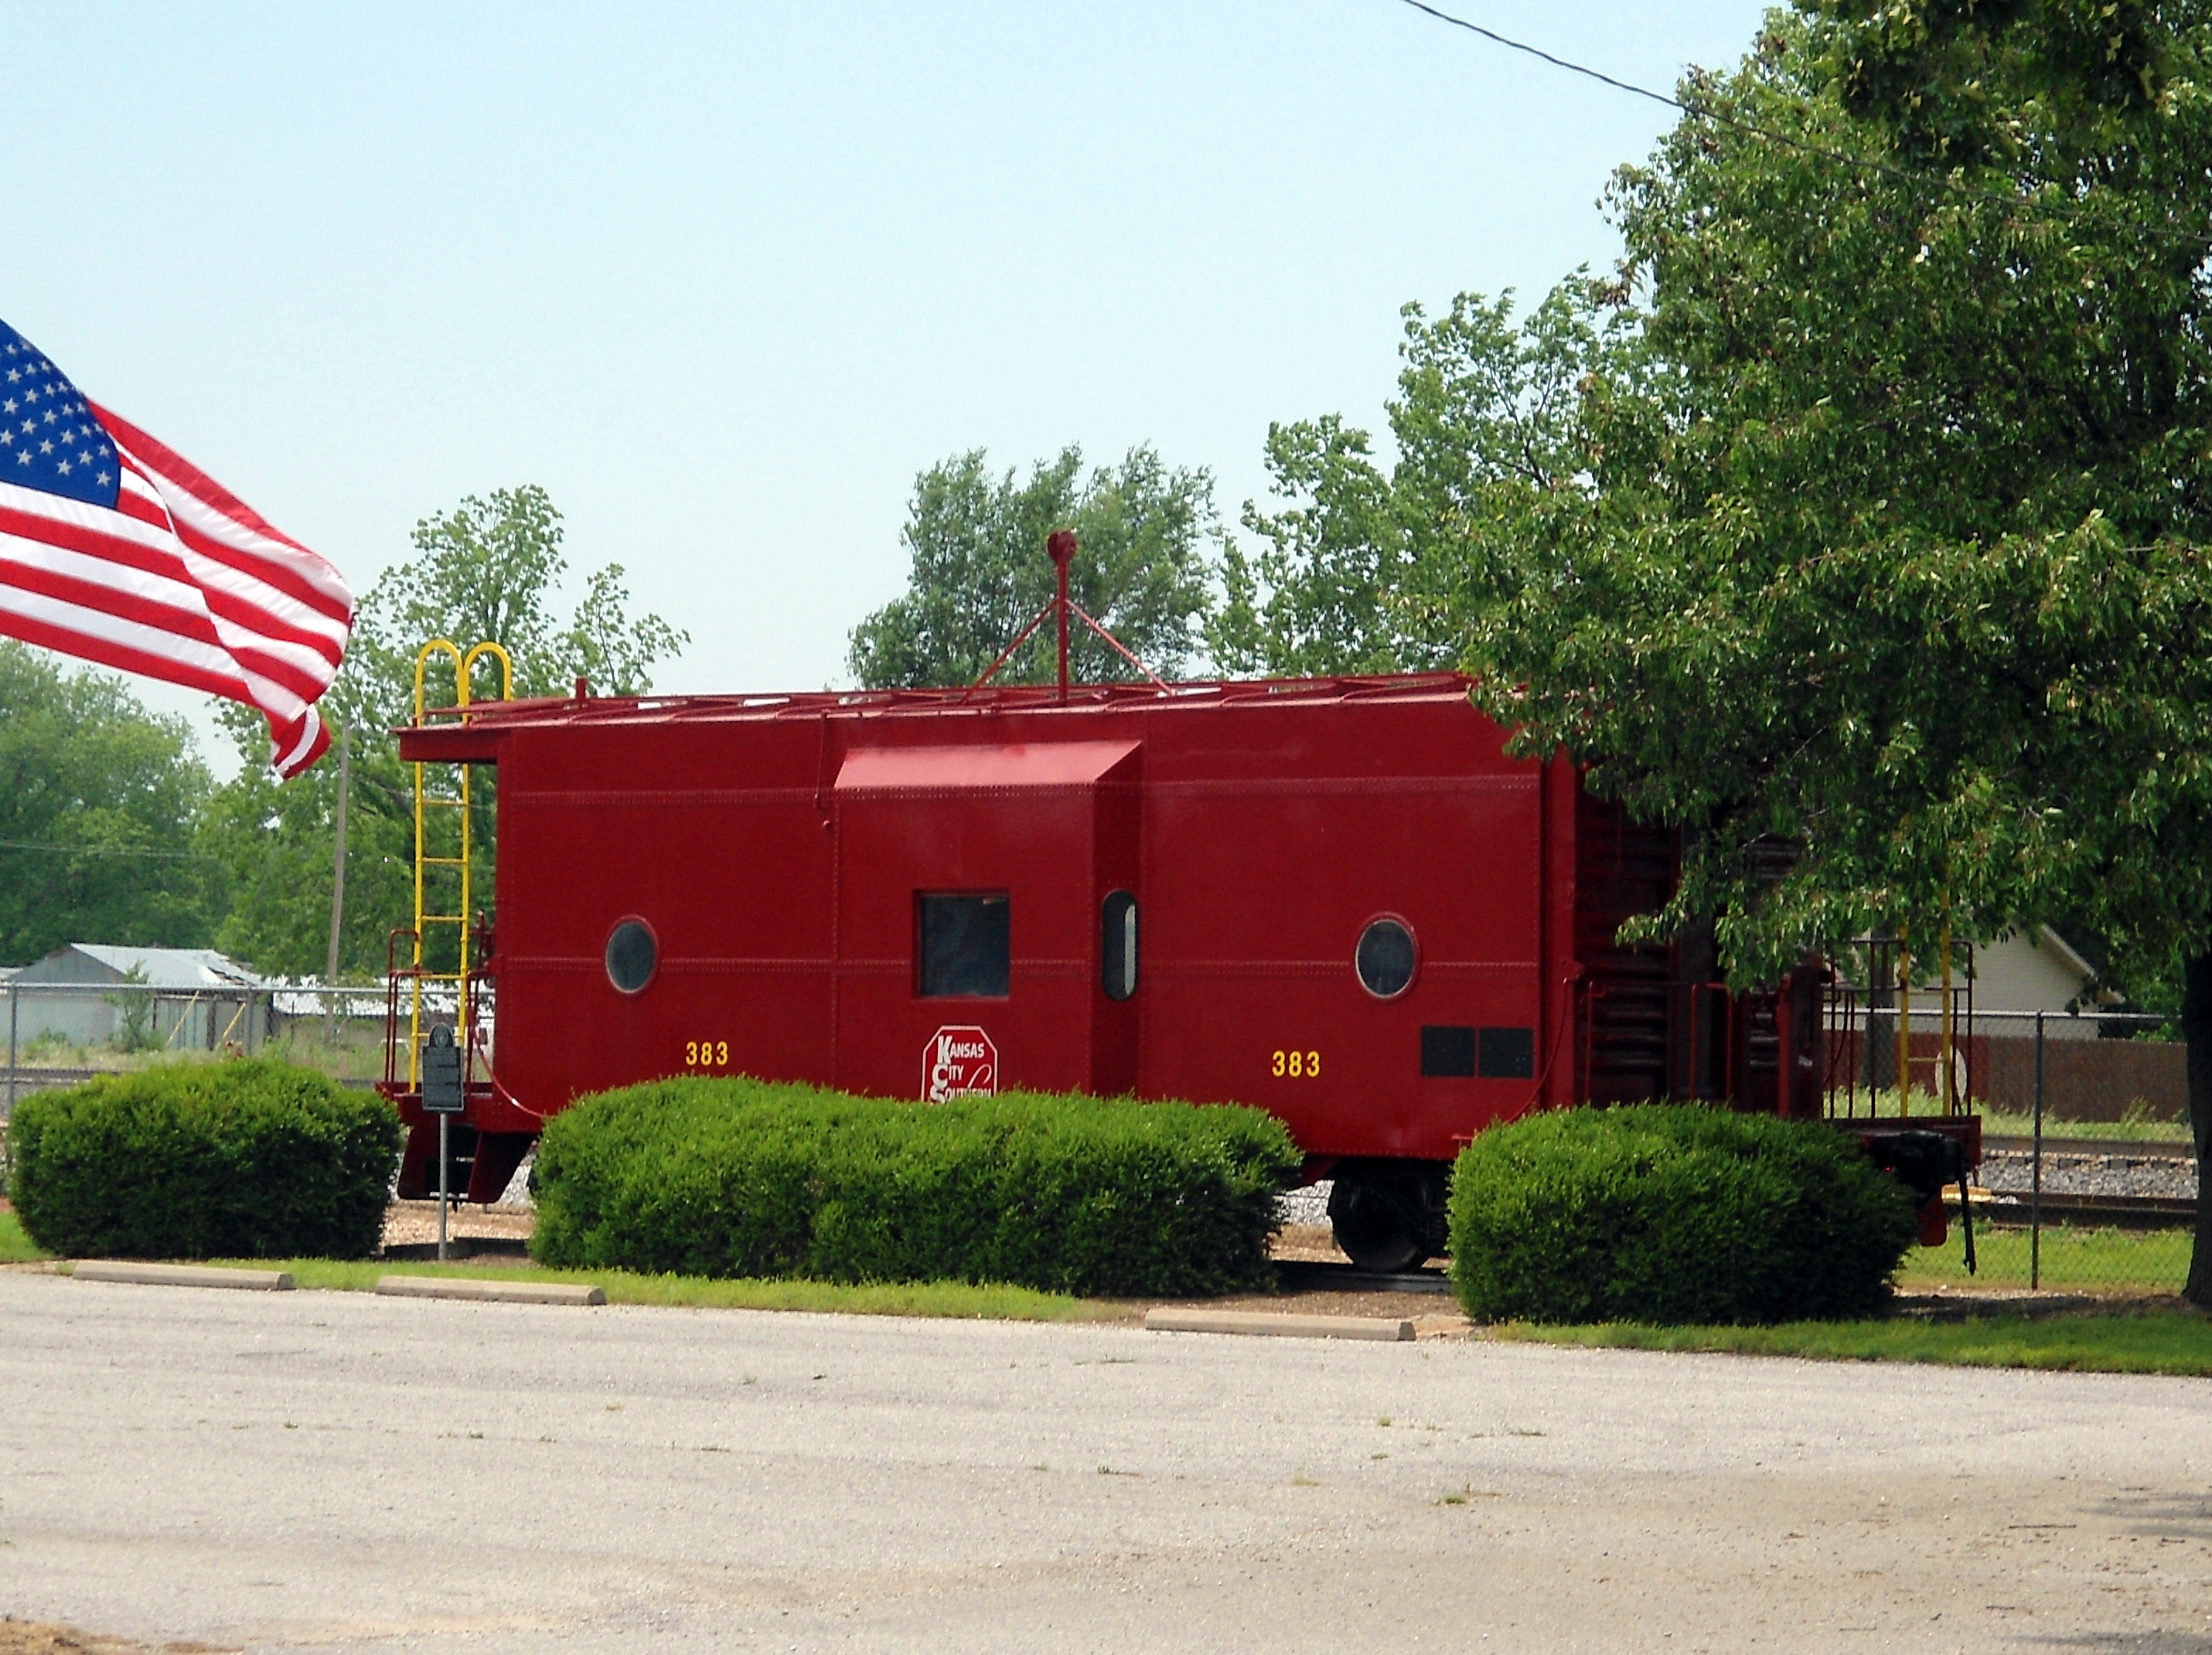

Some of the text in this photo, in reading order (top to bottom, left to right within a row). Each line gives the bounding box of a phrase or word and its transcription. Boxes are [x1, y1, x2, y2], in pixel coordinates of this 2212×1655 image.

[686, 1041, 728, 1065] 383
[937, 1035, 985, 1064] KANSAS
[932, 1064, 964, 1088] CITY
[1272, 1051, 1320, 1077] 383
